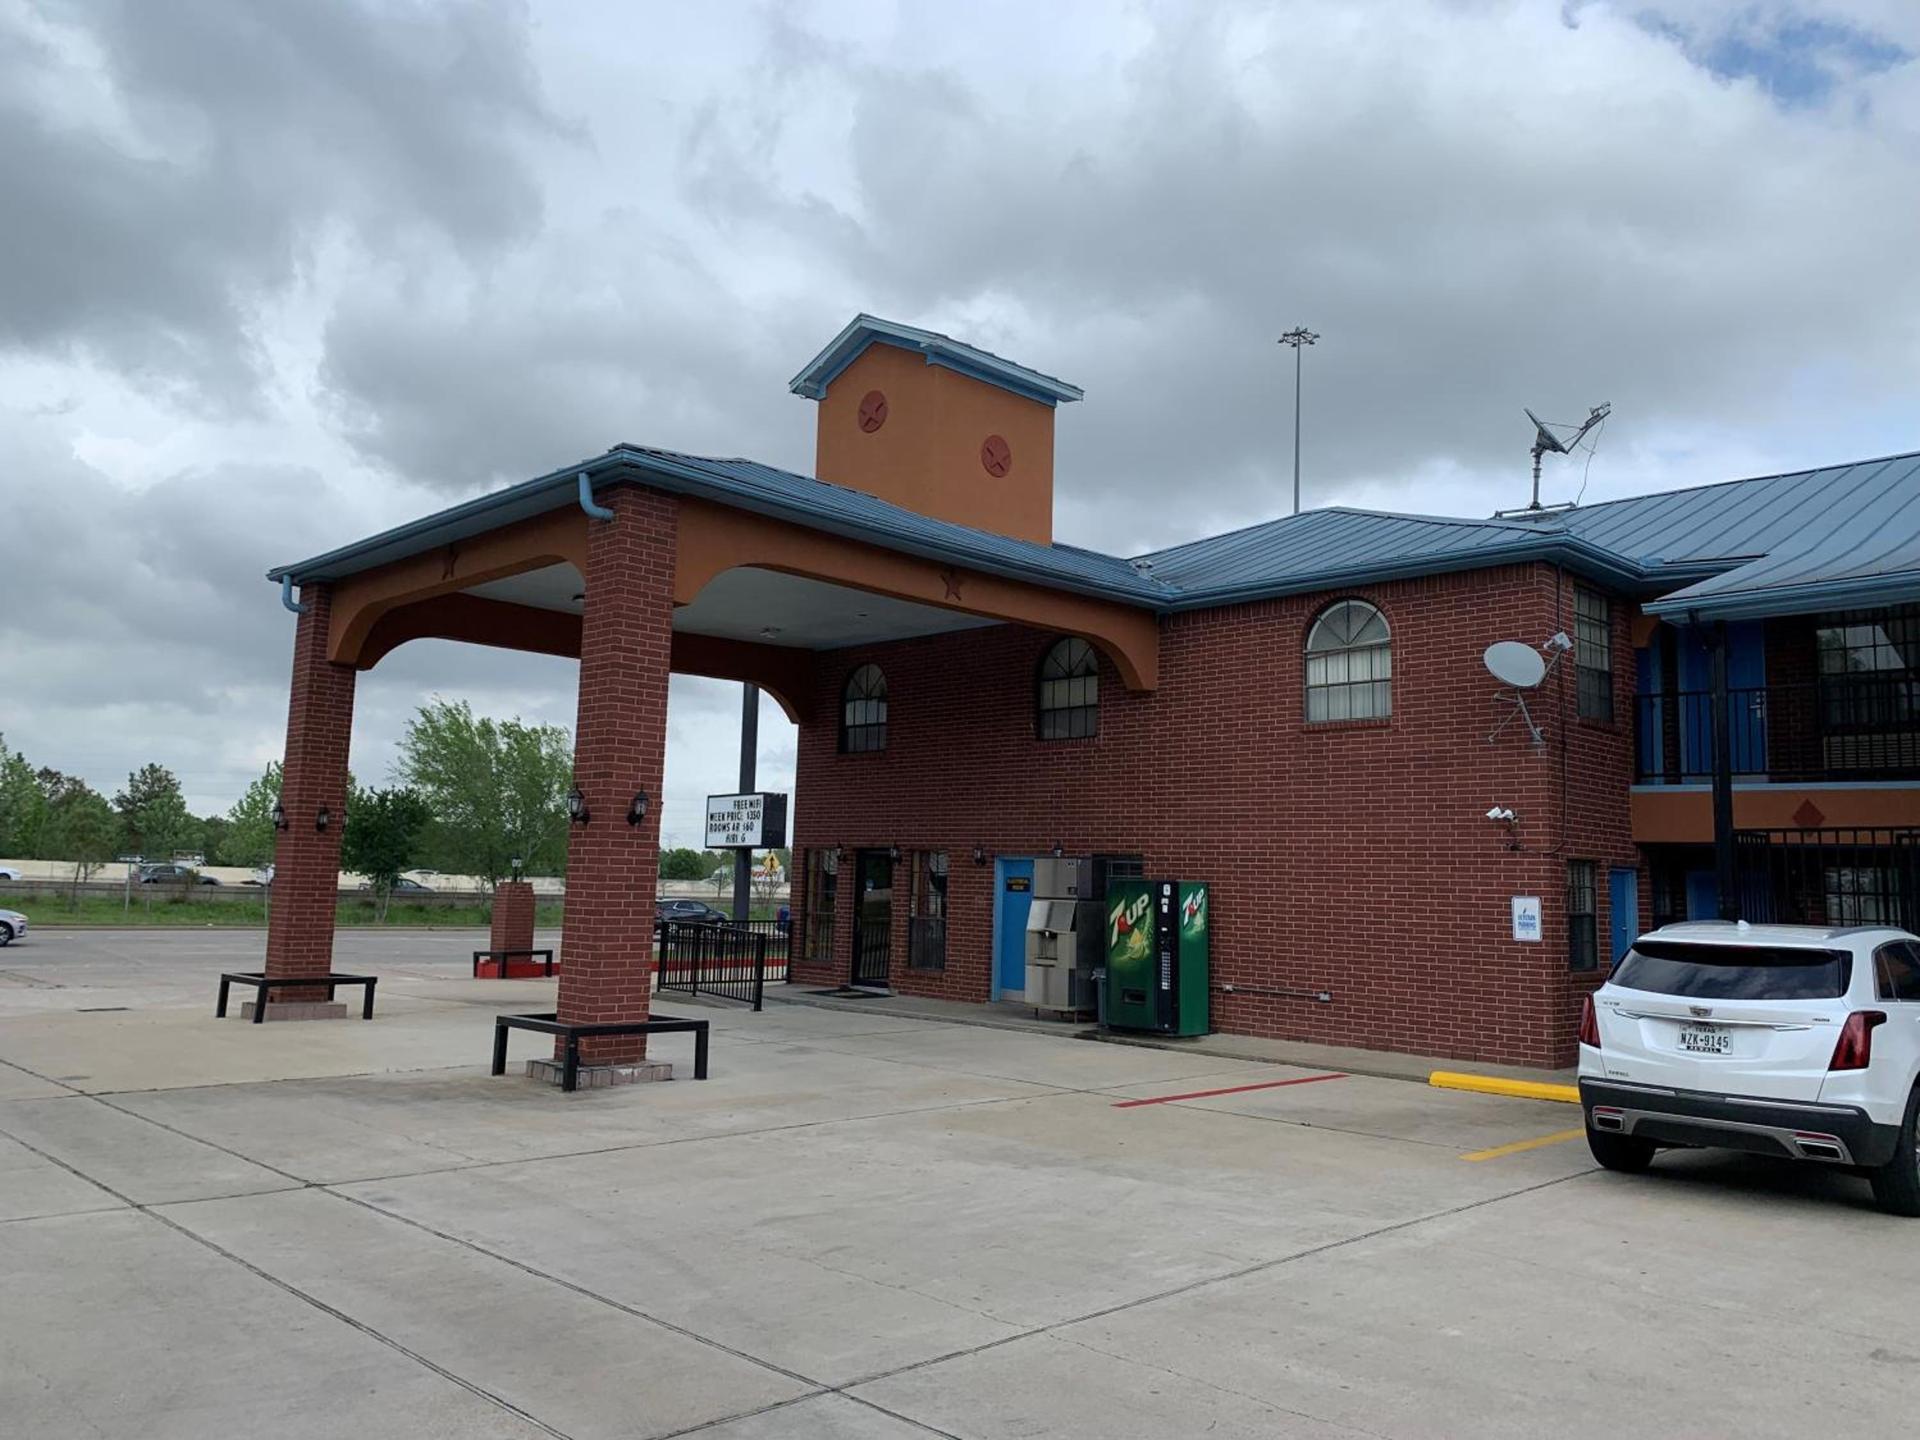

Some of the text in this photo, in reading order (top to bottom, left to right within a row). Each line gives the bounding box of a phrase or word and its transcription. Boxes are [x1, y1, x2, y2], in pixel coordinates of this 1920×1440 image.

[733, 798, 762, 810] FREE WIFI
[709, 812, 726, 822] WEEK
[709, 822, 731, 833] ROOMS
